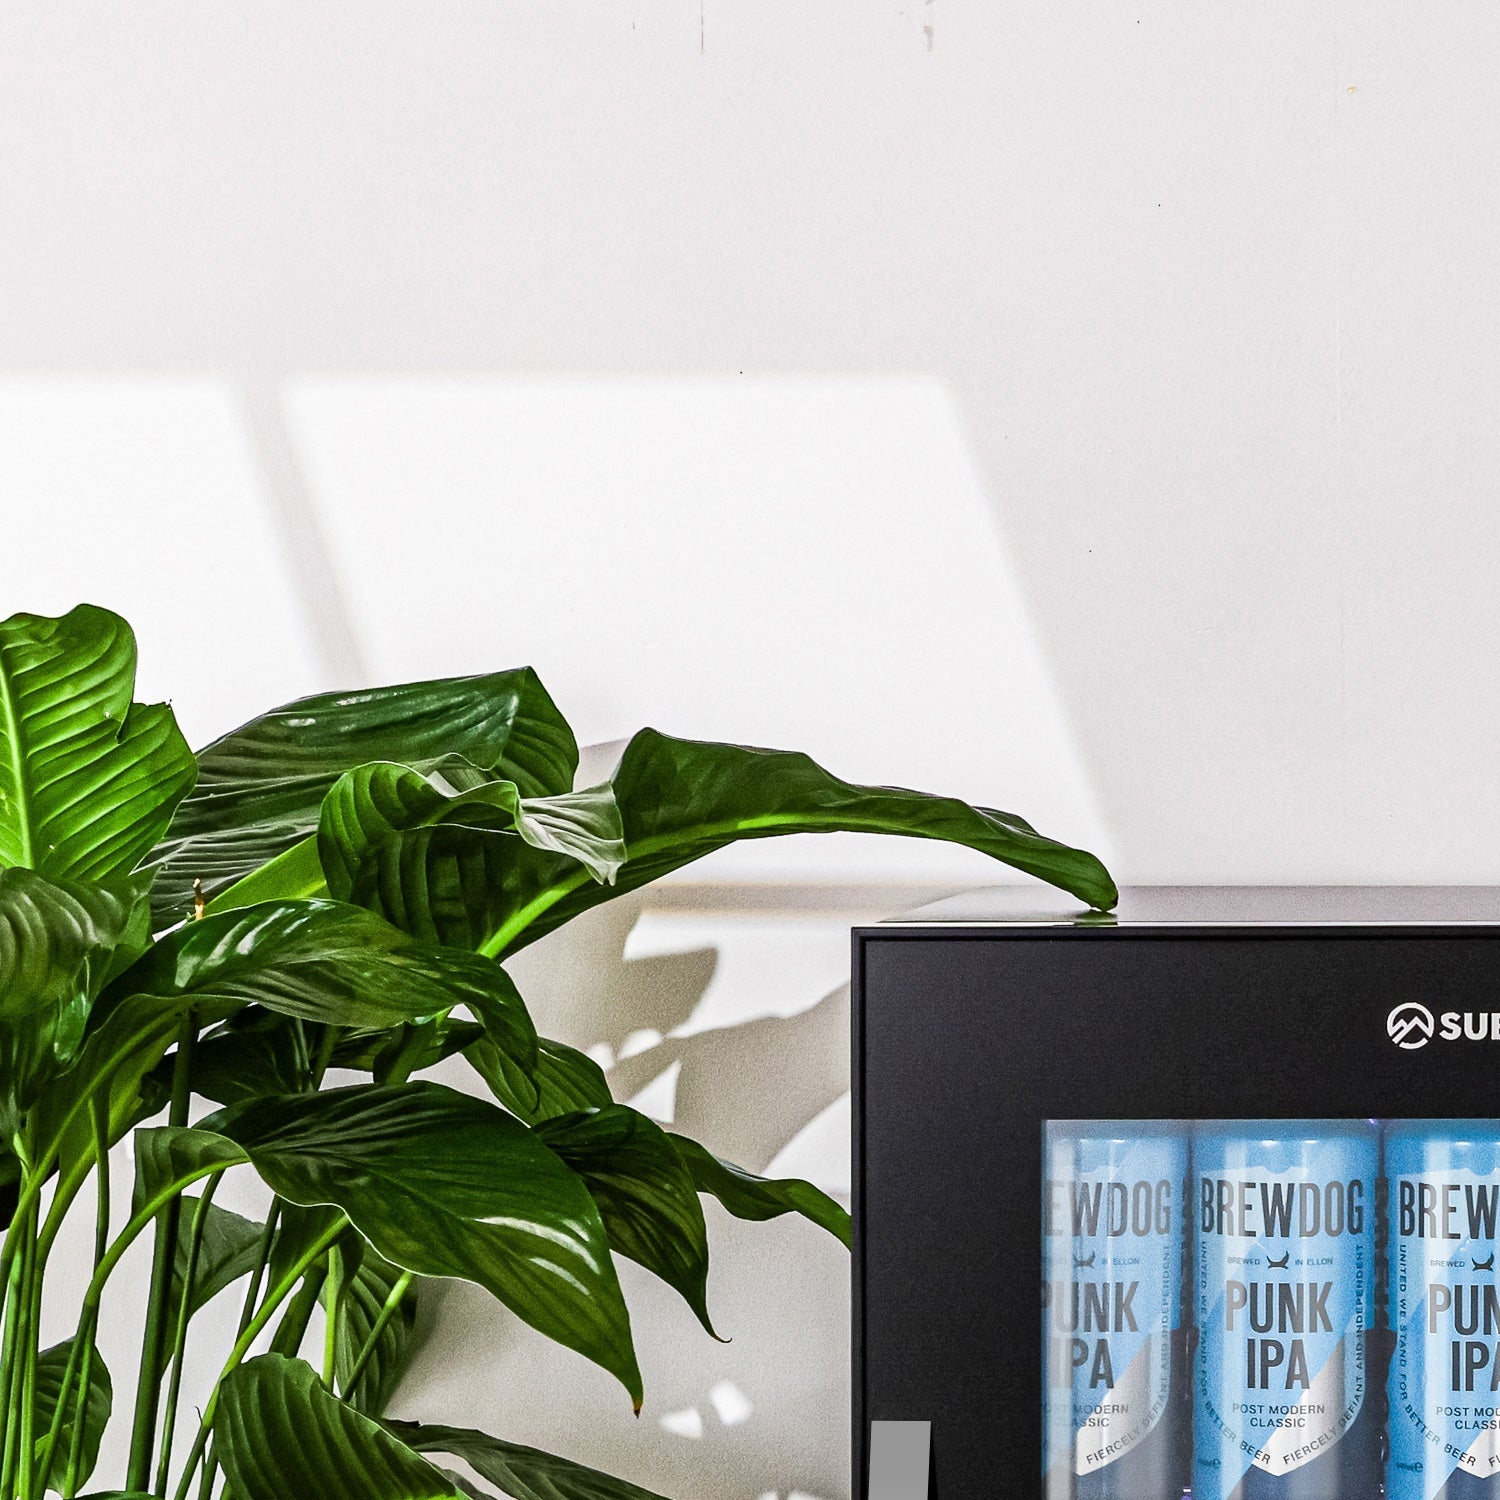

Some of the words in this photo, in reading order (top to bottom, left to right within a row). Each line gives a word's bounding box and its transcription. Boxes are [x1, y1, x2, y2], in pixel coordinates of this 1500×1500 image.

[1201, 1176, 1364, 1238] BREWDOG
[1227, 1256, 1261, 1266] BREWED
[1294, 1258, 1303, 1266] IN
[1306, 1257, 1334, 1266] ELLON
[1430, 1259, 1465, 1268] BREWED
[1356, 1244, 1364, 1338] INDEPENDENT
[1225, 1280, 1334, 1334] PUNK
[1400, 1299, 1407, 1318] WE
[1246, 1338, 1311, 1390] IPA
[1356, 1344, 1364, 1370] AND
[1400, 1373, 1408, 1400] FOR
[1232, 1403, 1268, 1414] POST
[1268, 1404, 1325, 1415] MODERN
[1339, 1376, 1364, 1430] DEFIANT
[1436, 1406, 1470, 1417] POST
[1250, 1417, 1306, 1428] CLASSIC
[1404, 1405, 1441, 1445] BETTER
[1086, 1427, 1141, 1465] FIERCELY
[1240, 1440, 1271, 1465] BEER
[1283, 1427, 1338, 1465] FIERCELY
[1444, 1443, 1477, 1467] BEER
